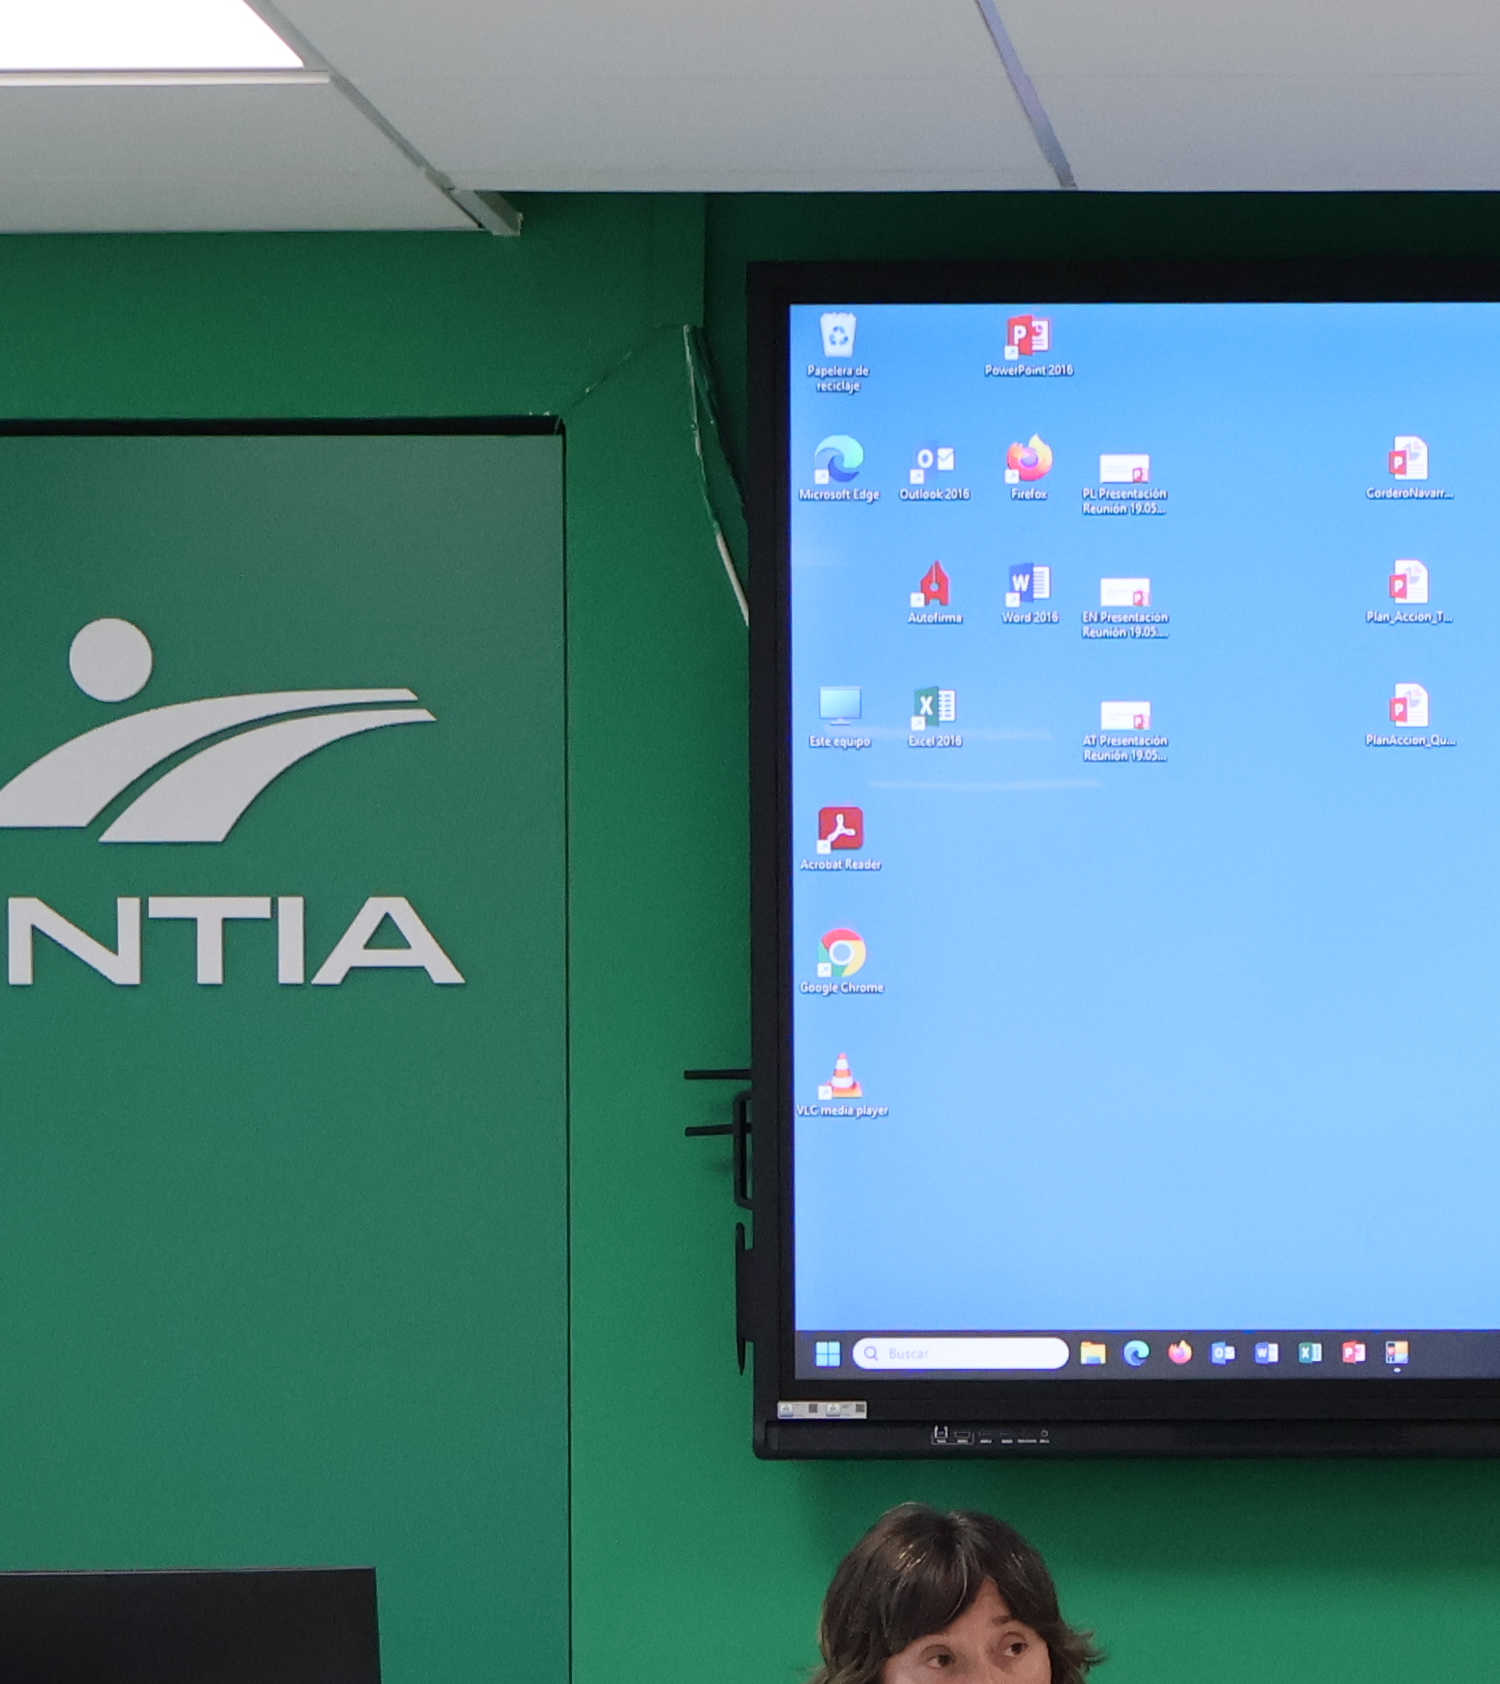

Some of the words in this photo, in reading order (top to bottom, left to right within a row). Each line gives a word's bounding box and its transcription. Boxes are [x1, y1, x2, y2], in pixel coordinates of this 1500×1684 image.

[807, 364, 853, 379] Papelera
[855, 364, 869, 376] de
[985, 364, 1046, 375] PowerPoint
[1049, 364, 1073, 375] 2016
[817, 380, 860, 394] reciclaje
[799, 488, 850, 500] Microsoft
[853, 488, 879, 502] Edge
[900, 488, 943, 500] Outlook
[945, 488, 969, 500] 2016
[1011, 488, 1047, 499] Firefox
[1083, 488, 1095, 499] PL
[1099, 487, 1167, 499] Presentación
[1366, 487, 1453, 499] CorderoNavarr...
[1083, 502, 1127, 514] Reunión
[908, 611, 962, 623] Autofirma
[1002, 611, 1031, 623] Word
[1034, 611, 1059, 622] 2016
[1083, 611, 1097, 622] EN
[1101, 611, 1168, 623] Presentación
[1367, 610, 1453, 624] Plan_Accion_T...
[1083, 626, 1127, 638] Reunión
[810, 735, 831, 747] Este
[833, 736, 871, 750] equipo
[909, 735, 935, 747] Excel
[937, 735, 962, 747] 2016
[1083, 734, 1096, 745] AT
[1100, 734, 1168, 746] Presentación
[1366, 734, 1456, 747] PlanAccion_Qu...
[1084, 750, 1128, 761] Reunión
[800, 859, 842, 870] Acrobat
[845, 859, 881, 870] Reader
[800, 982, 838, 995] Google
[841, 982, 884, 993] Chrome
[797, 1105, 818, 1116] VLC
[821, 1105, 853, 1116] media
[856, 1105, 888, 1119] player
[888, 1347, 929, 1360] Buscar
